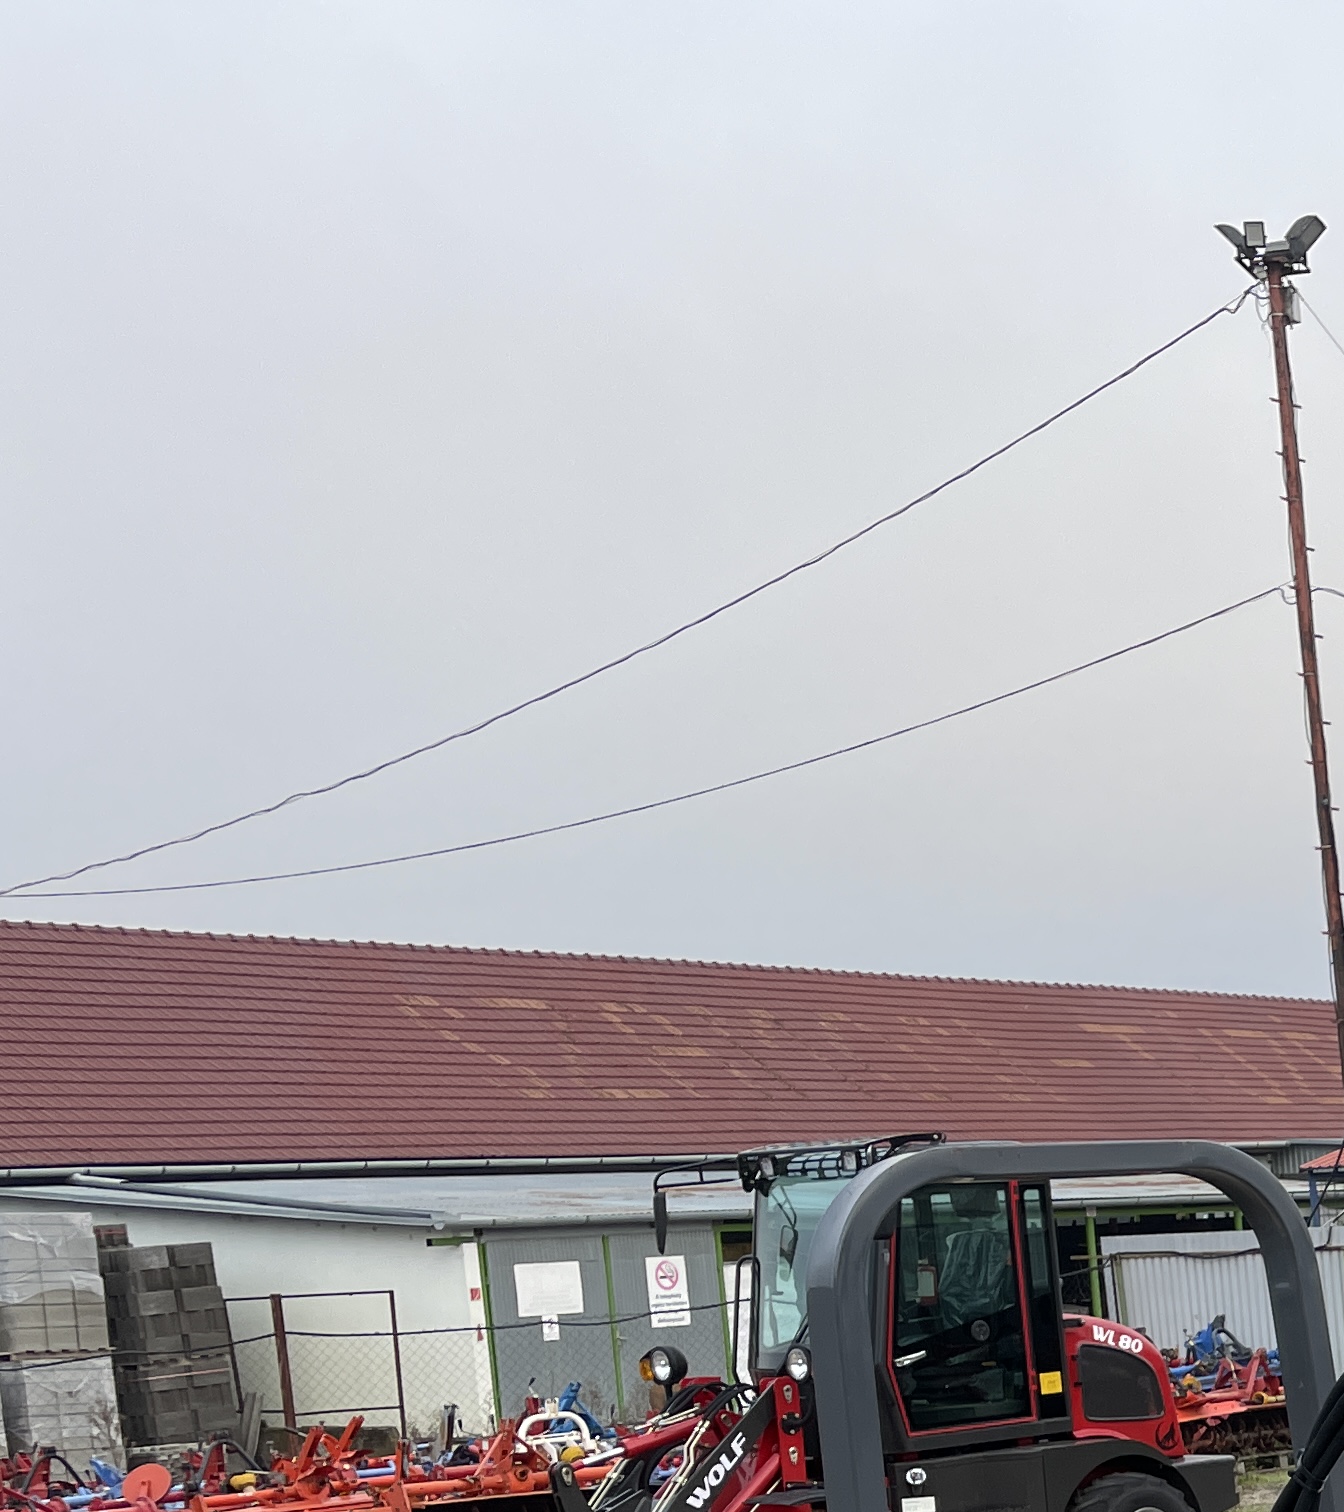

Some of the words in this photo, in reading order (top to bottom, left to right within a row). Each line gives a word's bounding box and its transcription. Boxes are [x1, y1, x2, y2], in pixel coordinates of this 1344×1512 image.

[1092, 1325, 1117, 1347] WL
[1118, 1334, 1144, 1354] 80
[685, 1431, 746, 1509] WOLF
